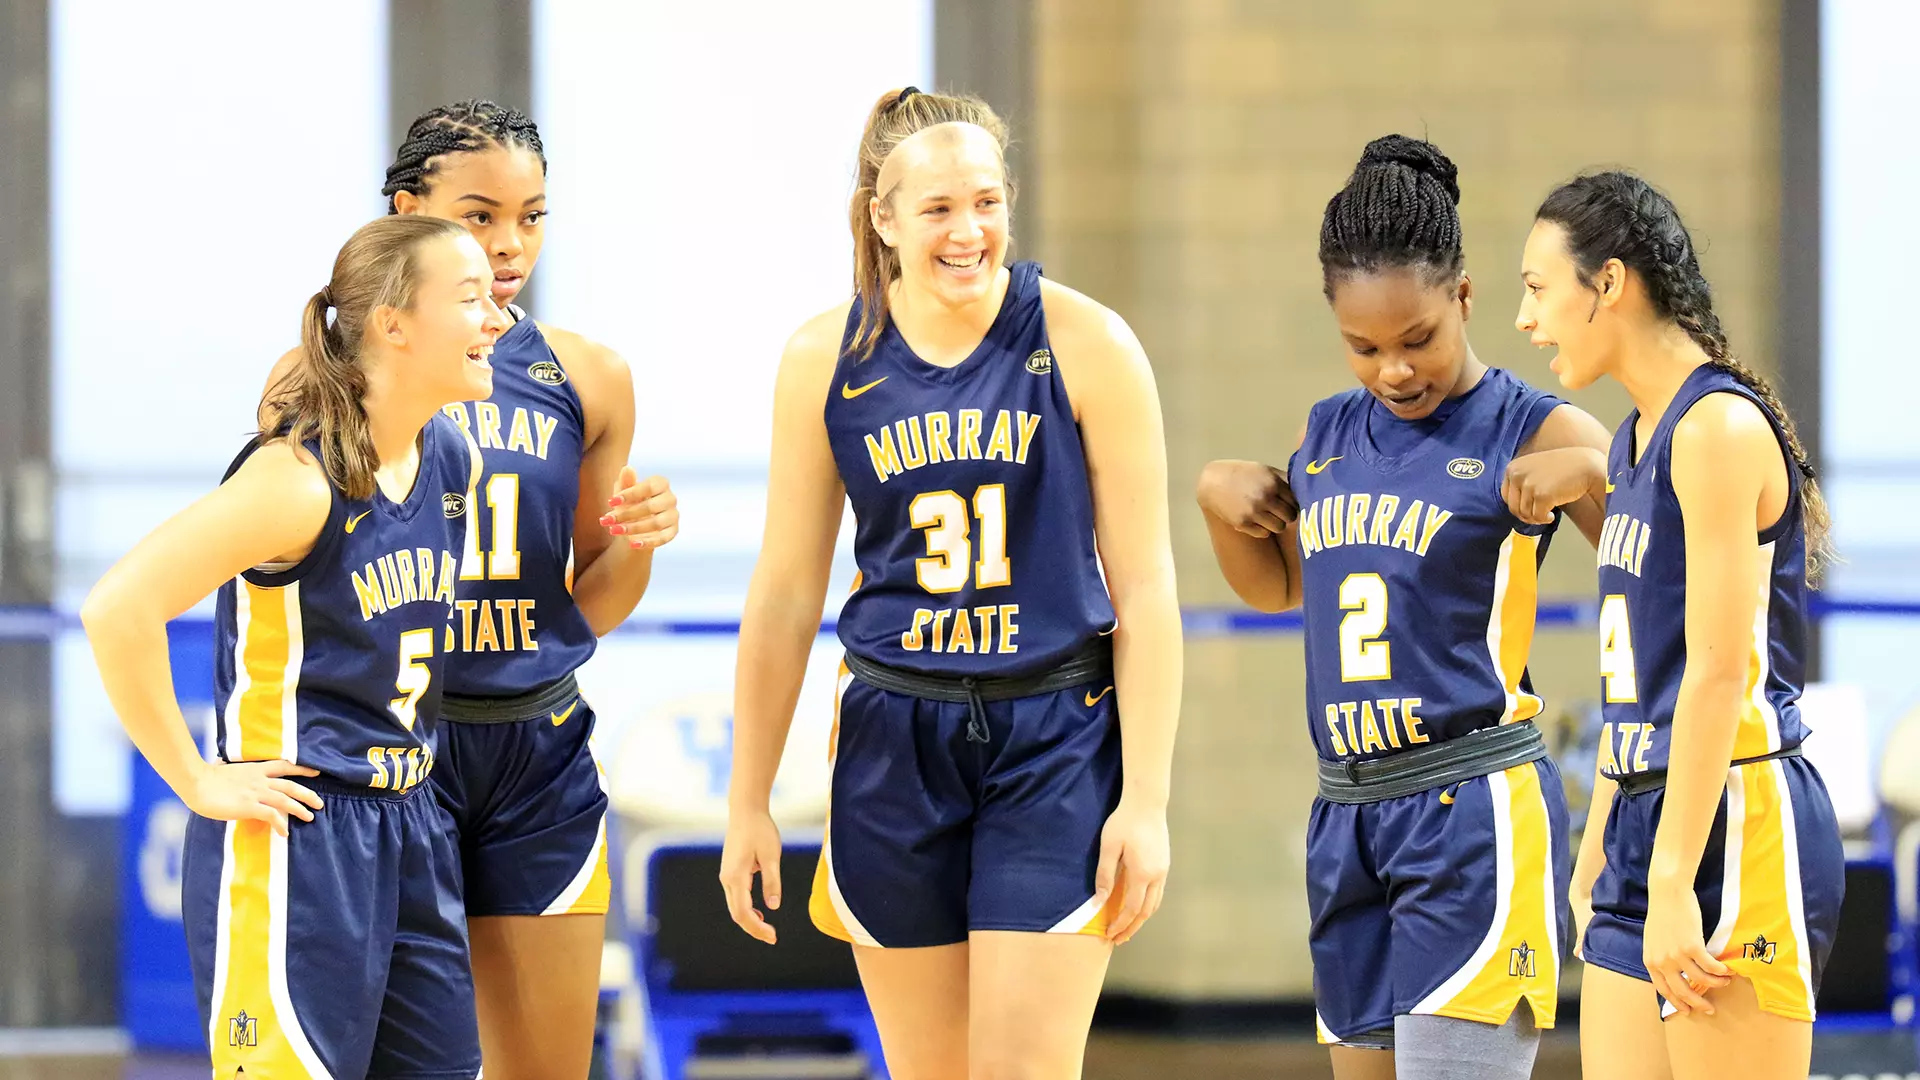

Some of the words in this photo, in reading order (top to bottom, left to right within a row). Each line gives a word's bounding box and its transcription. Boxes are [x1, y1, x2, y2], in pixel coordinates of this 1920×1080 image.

[863, 408, 1042, 484] MURRAY
[459, 473, 521, 581] 11
[908, 483, 1012, 595] 31
[1299, 493, 1454, 560] MURRAY
[1597, 513, 1651, 578] RRAY
[351, 547, 457, 622] MURRA
[901, 604, 1019, 654] STATE
[1339, 572, 1392, 683] 2
[1599, 594, 1638, 704] 4
[388, 627, 434, 732] 5
[1325, 697, 1431, 757] STATE
